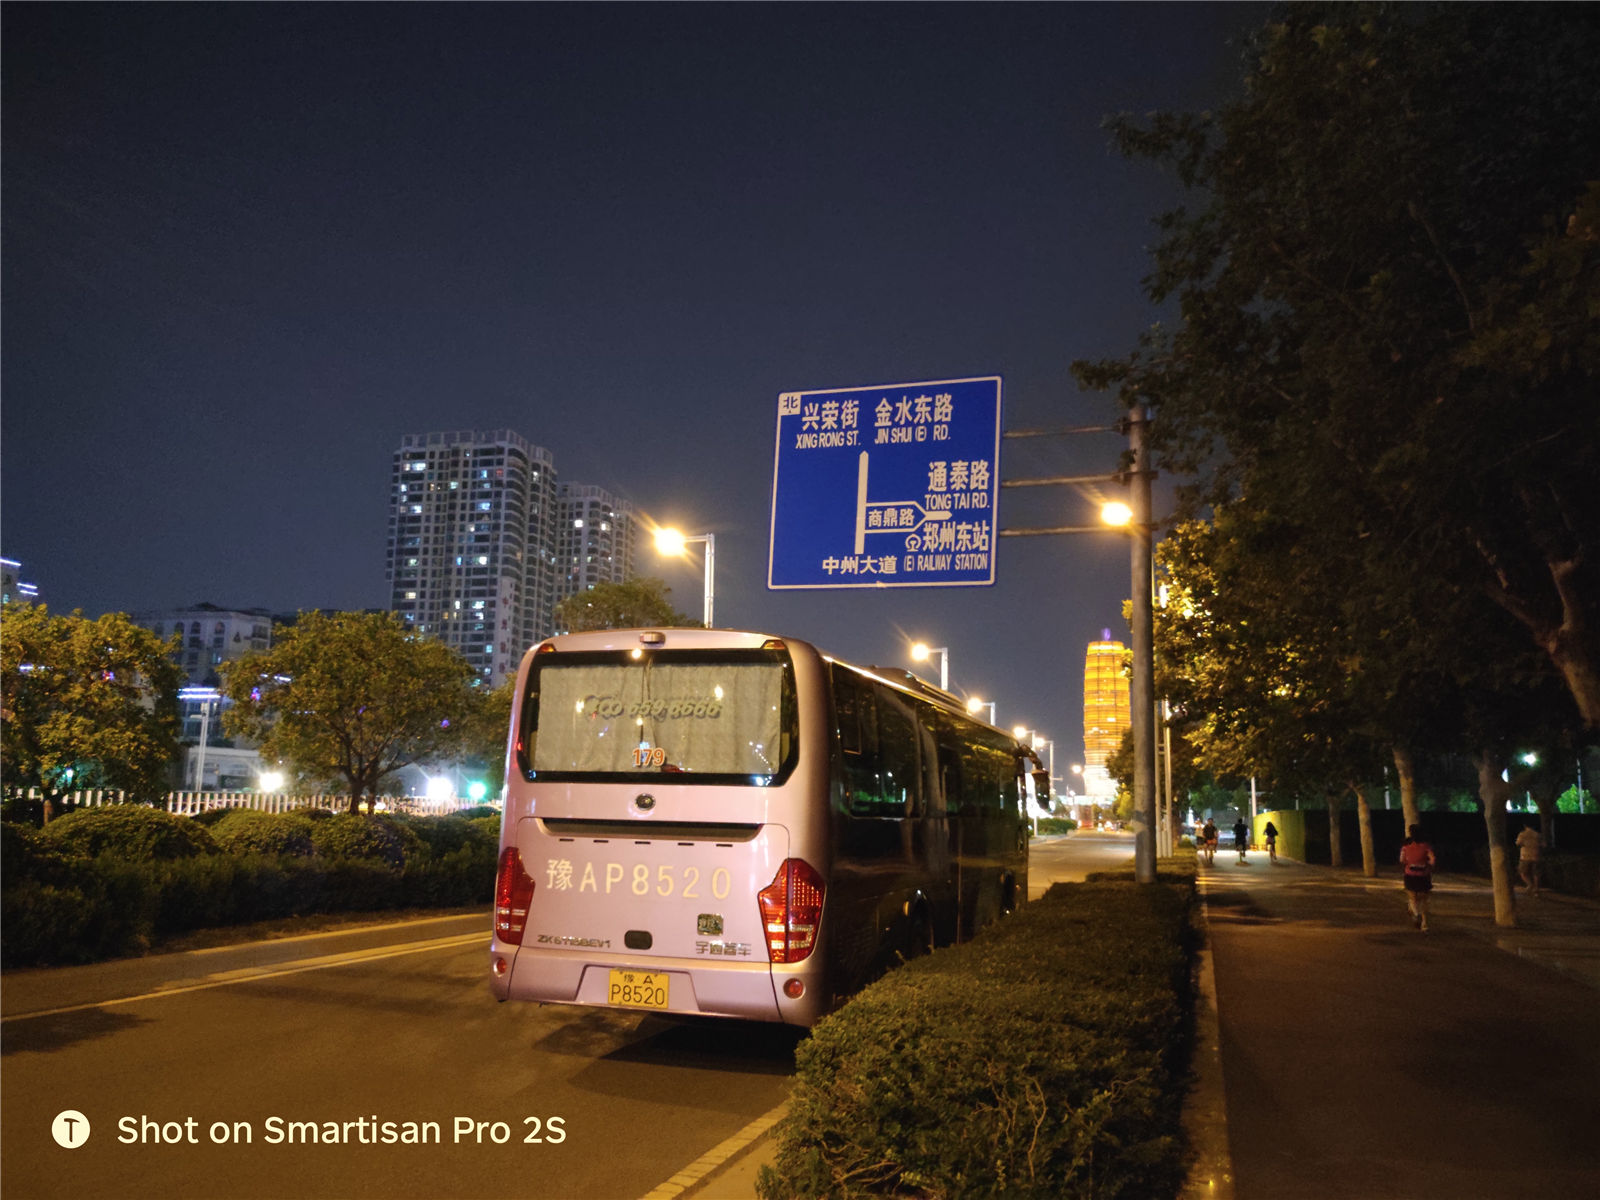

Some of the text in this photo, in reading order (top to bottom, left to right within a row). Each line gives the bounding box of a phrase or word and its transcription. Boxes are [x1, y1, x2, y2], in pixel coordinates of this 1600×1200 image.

[782, 395, 799, 410] 北
[874, 393, 954, 428] 金水东路
[802, 400, 860, 431] 兴荣街
[796, 430, 862, 449] XING RONG ST.
[874, 424, 951, 444] JIN SHUI (E) RD.
[928, 460, 990, 492] 通泰路
[925, 493, 990, 510] TONG TAI RD.
[868, 508, 915, 528] 商鼎路
[922, 520, 989, 553] 郑州东站
[822, 555, 897, 575] 中州大道
[903, 554, 988, 572] (E) RAILWAY STATION
[632, 747, 665, 767] 179
[545, 858, 732, 900] 豫AP8520
[610, 983, 666, 1006] P8520
